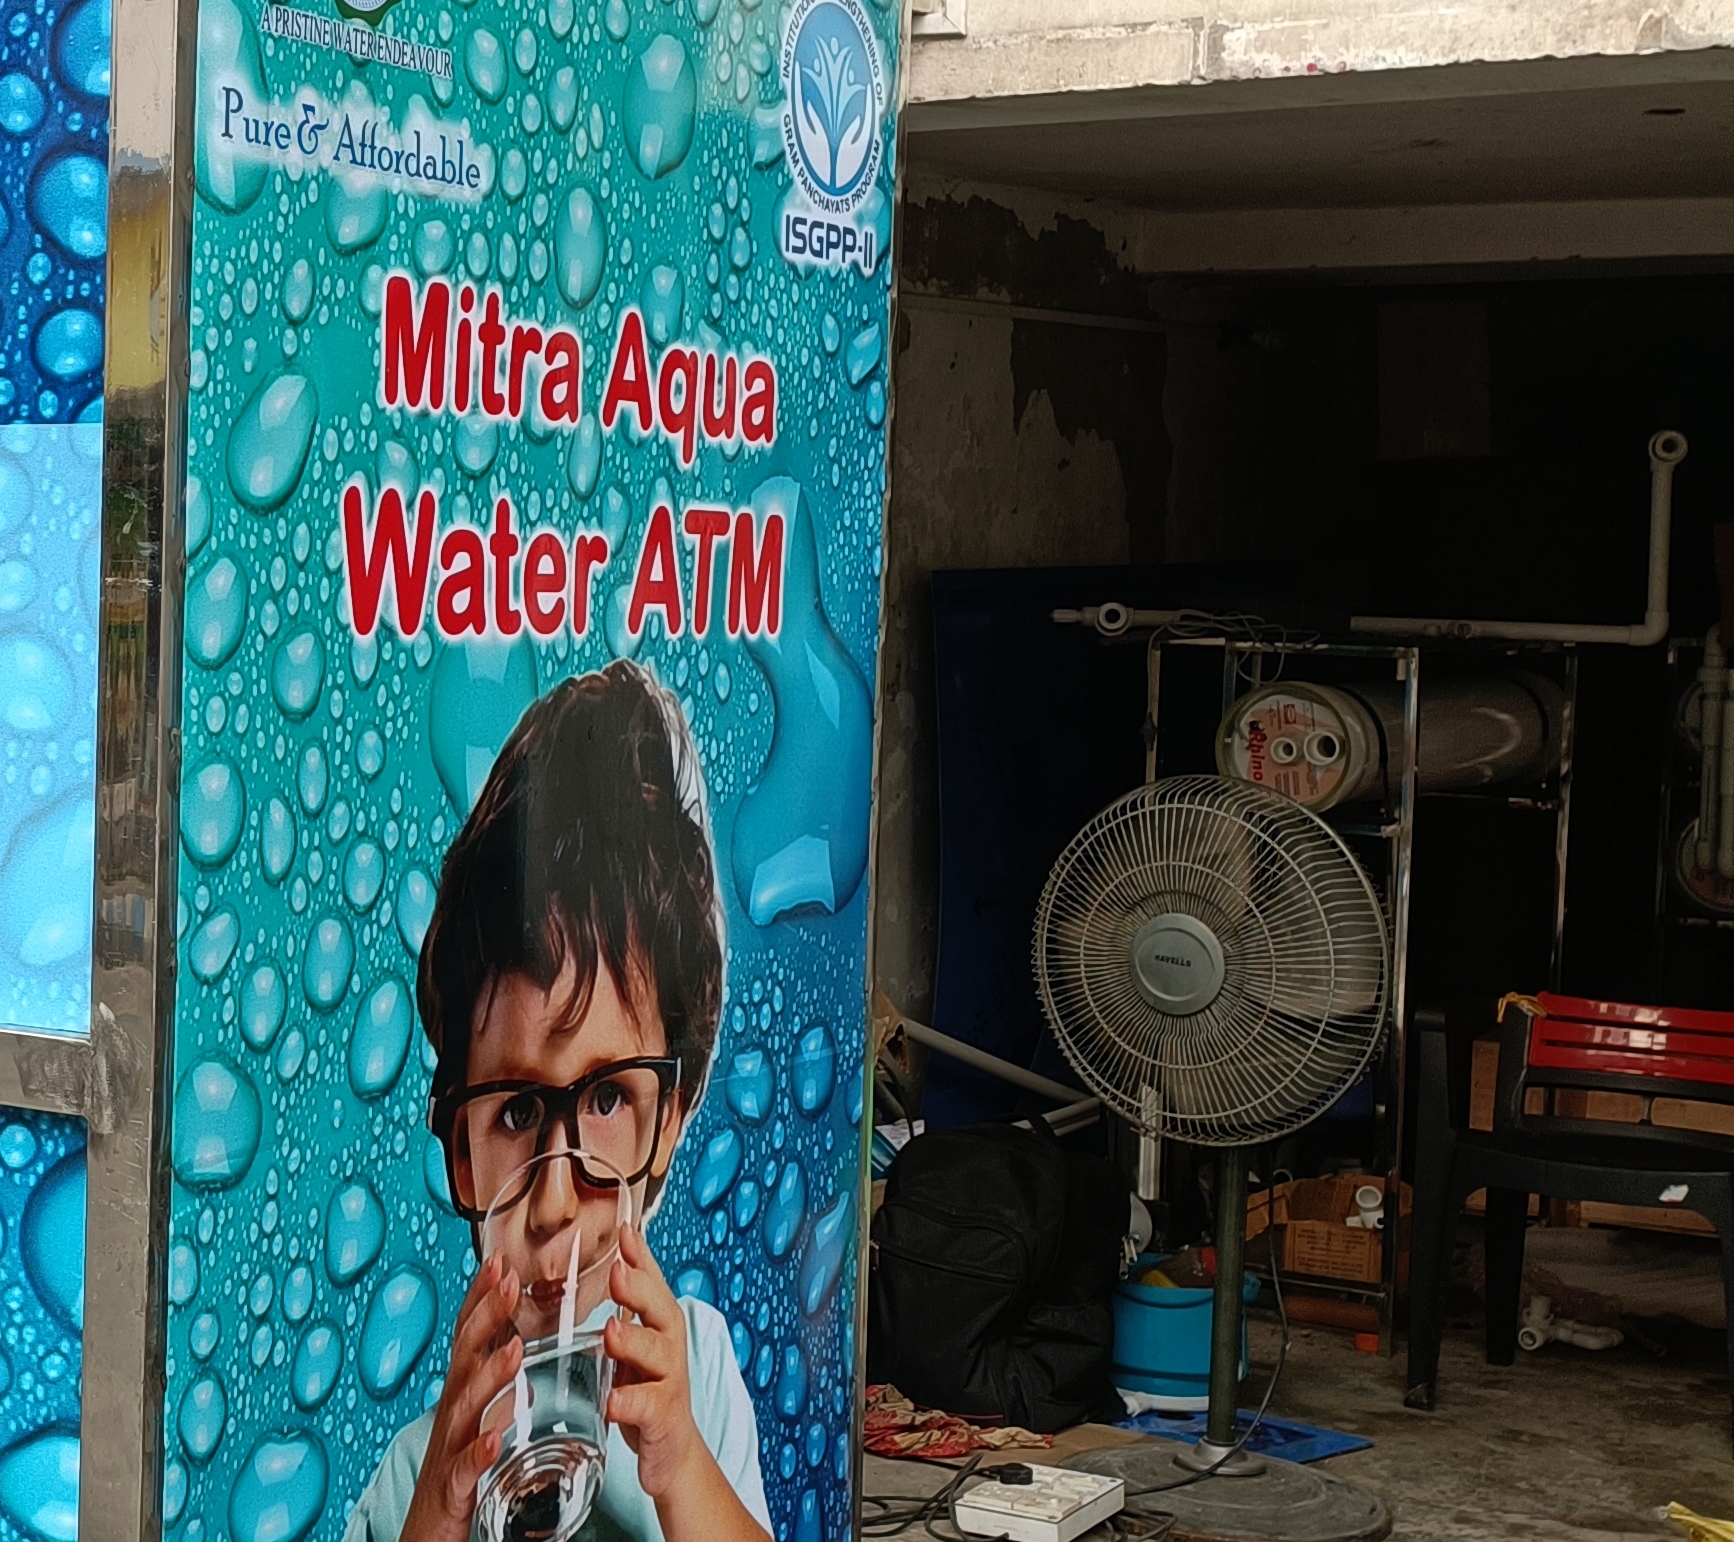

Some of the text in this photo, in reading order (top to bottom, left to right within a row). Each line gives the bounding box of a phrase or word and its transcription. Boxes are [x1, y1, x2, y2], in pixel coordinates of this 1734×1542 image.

[261, 6, 452, 77] A PRISTINE WATER ENDEAVOUR
[875, 81, 884, 106] OF
[221, 86, 481, 189] Pure & Affordable
[783, 113, 881, 214] GRAM PANCHAYATS PROGRAM
[785, 214, 874, 269] ISGPP-II
[381, 276, 776, 466] Mitra Aqua
[340, 486, 785, 640] Water ATM
[1250, 726, 1267, 781] Rhino
[1155, 955, 1191, 967] HAVELLS
